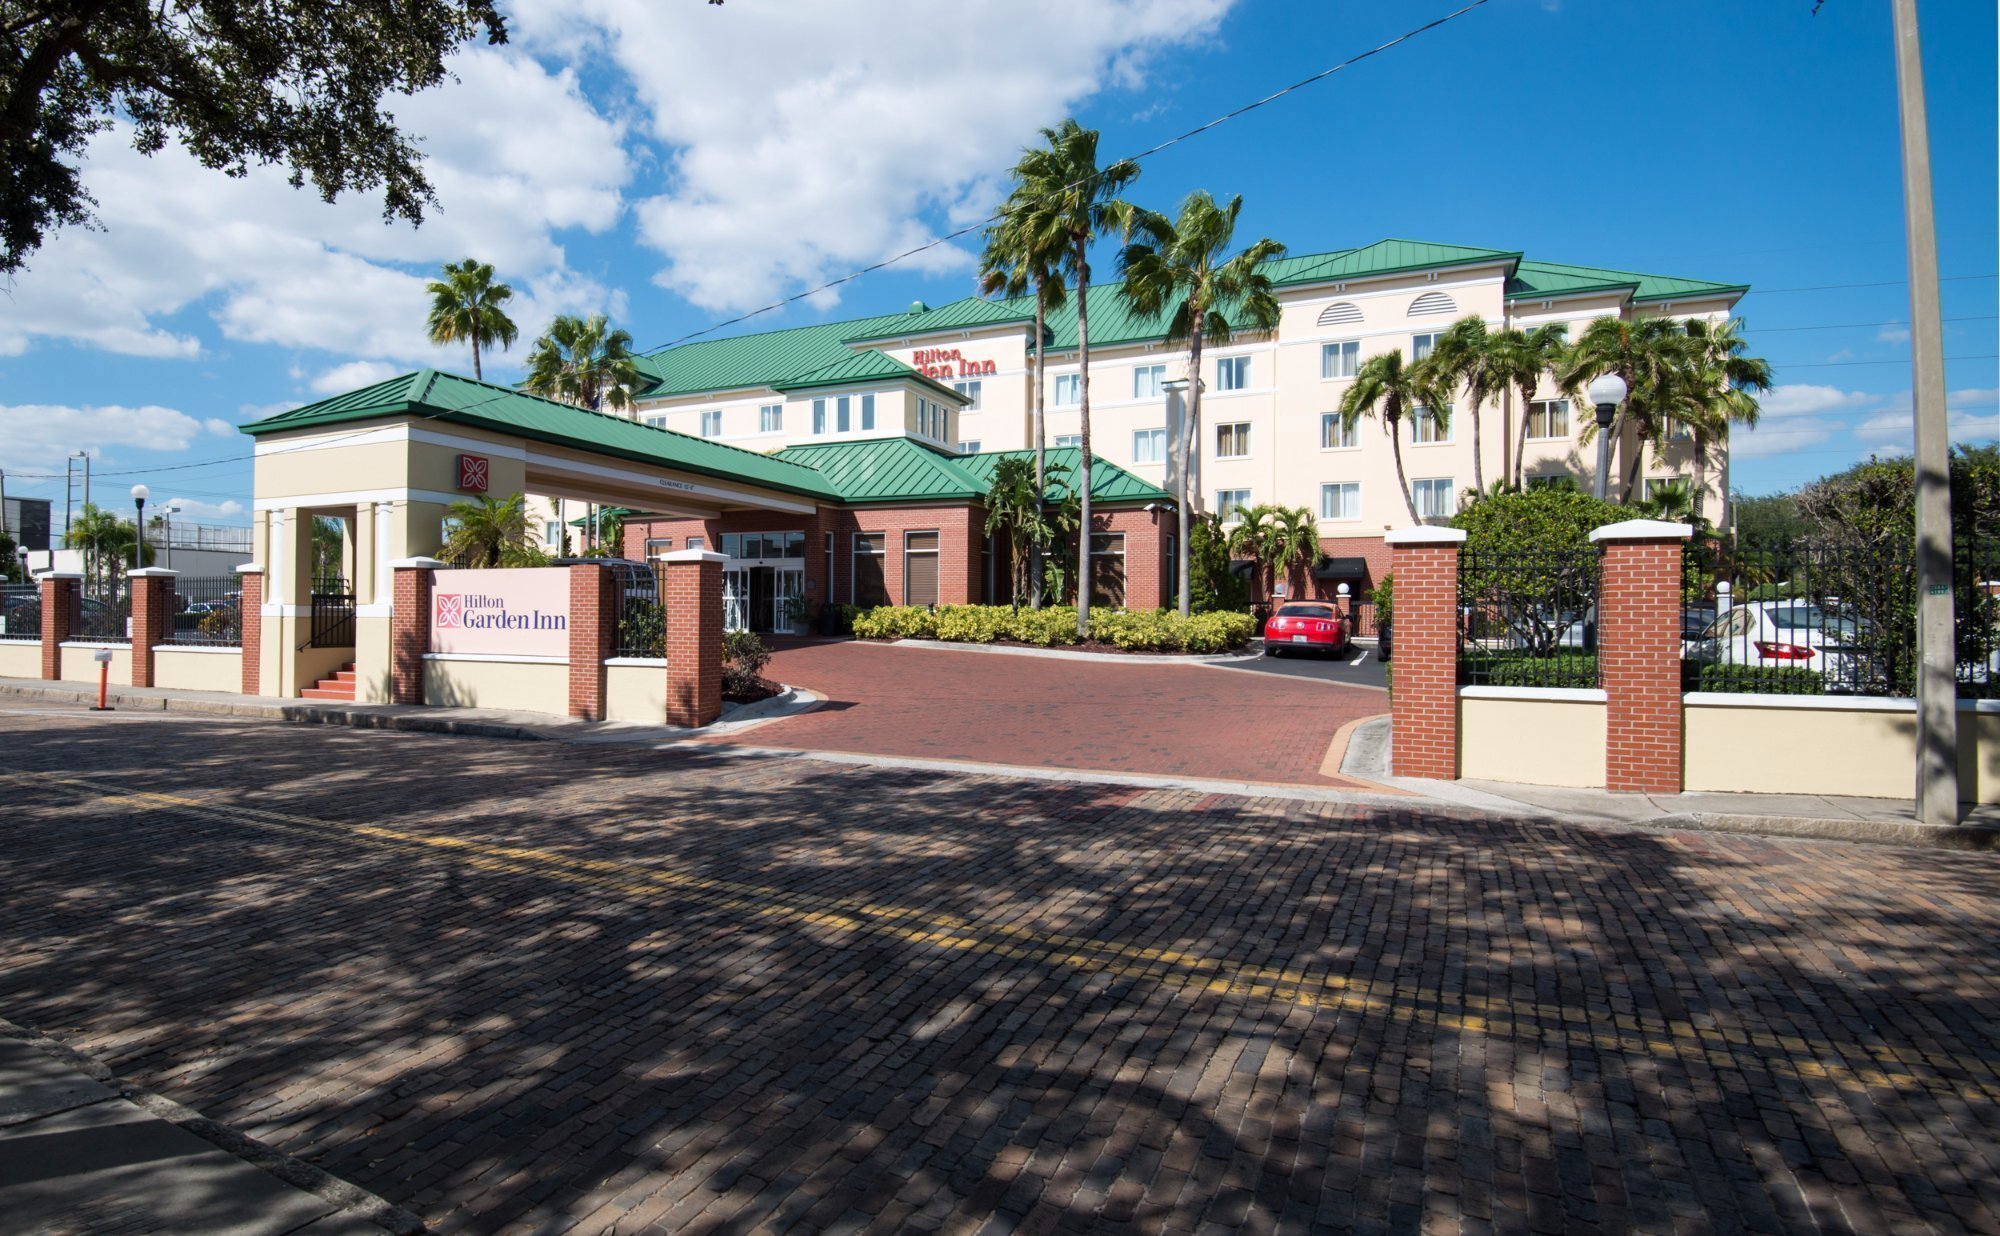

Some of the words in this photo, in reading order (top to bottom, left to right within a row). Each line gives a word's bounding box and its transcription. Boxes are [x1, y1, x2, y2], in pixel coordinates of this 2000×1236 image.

[913, 348, 961, 365] Hilton
[959, 358, 996, 376] Inn
[464, 594, 504, 608] Hilton
[463, 609, 530, 629] Garden
[532, 609, 566, 630] Inn
